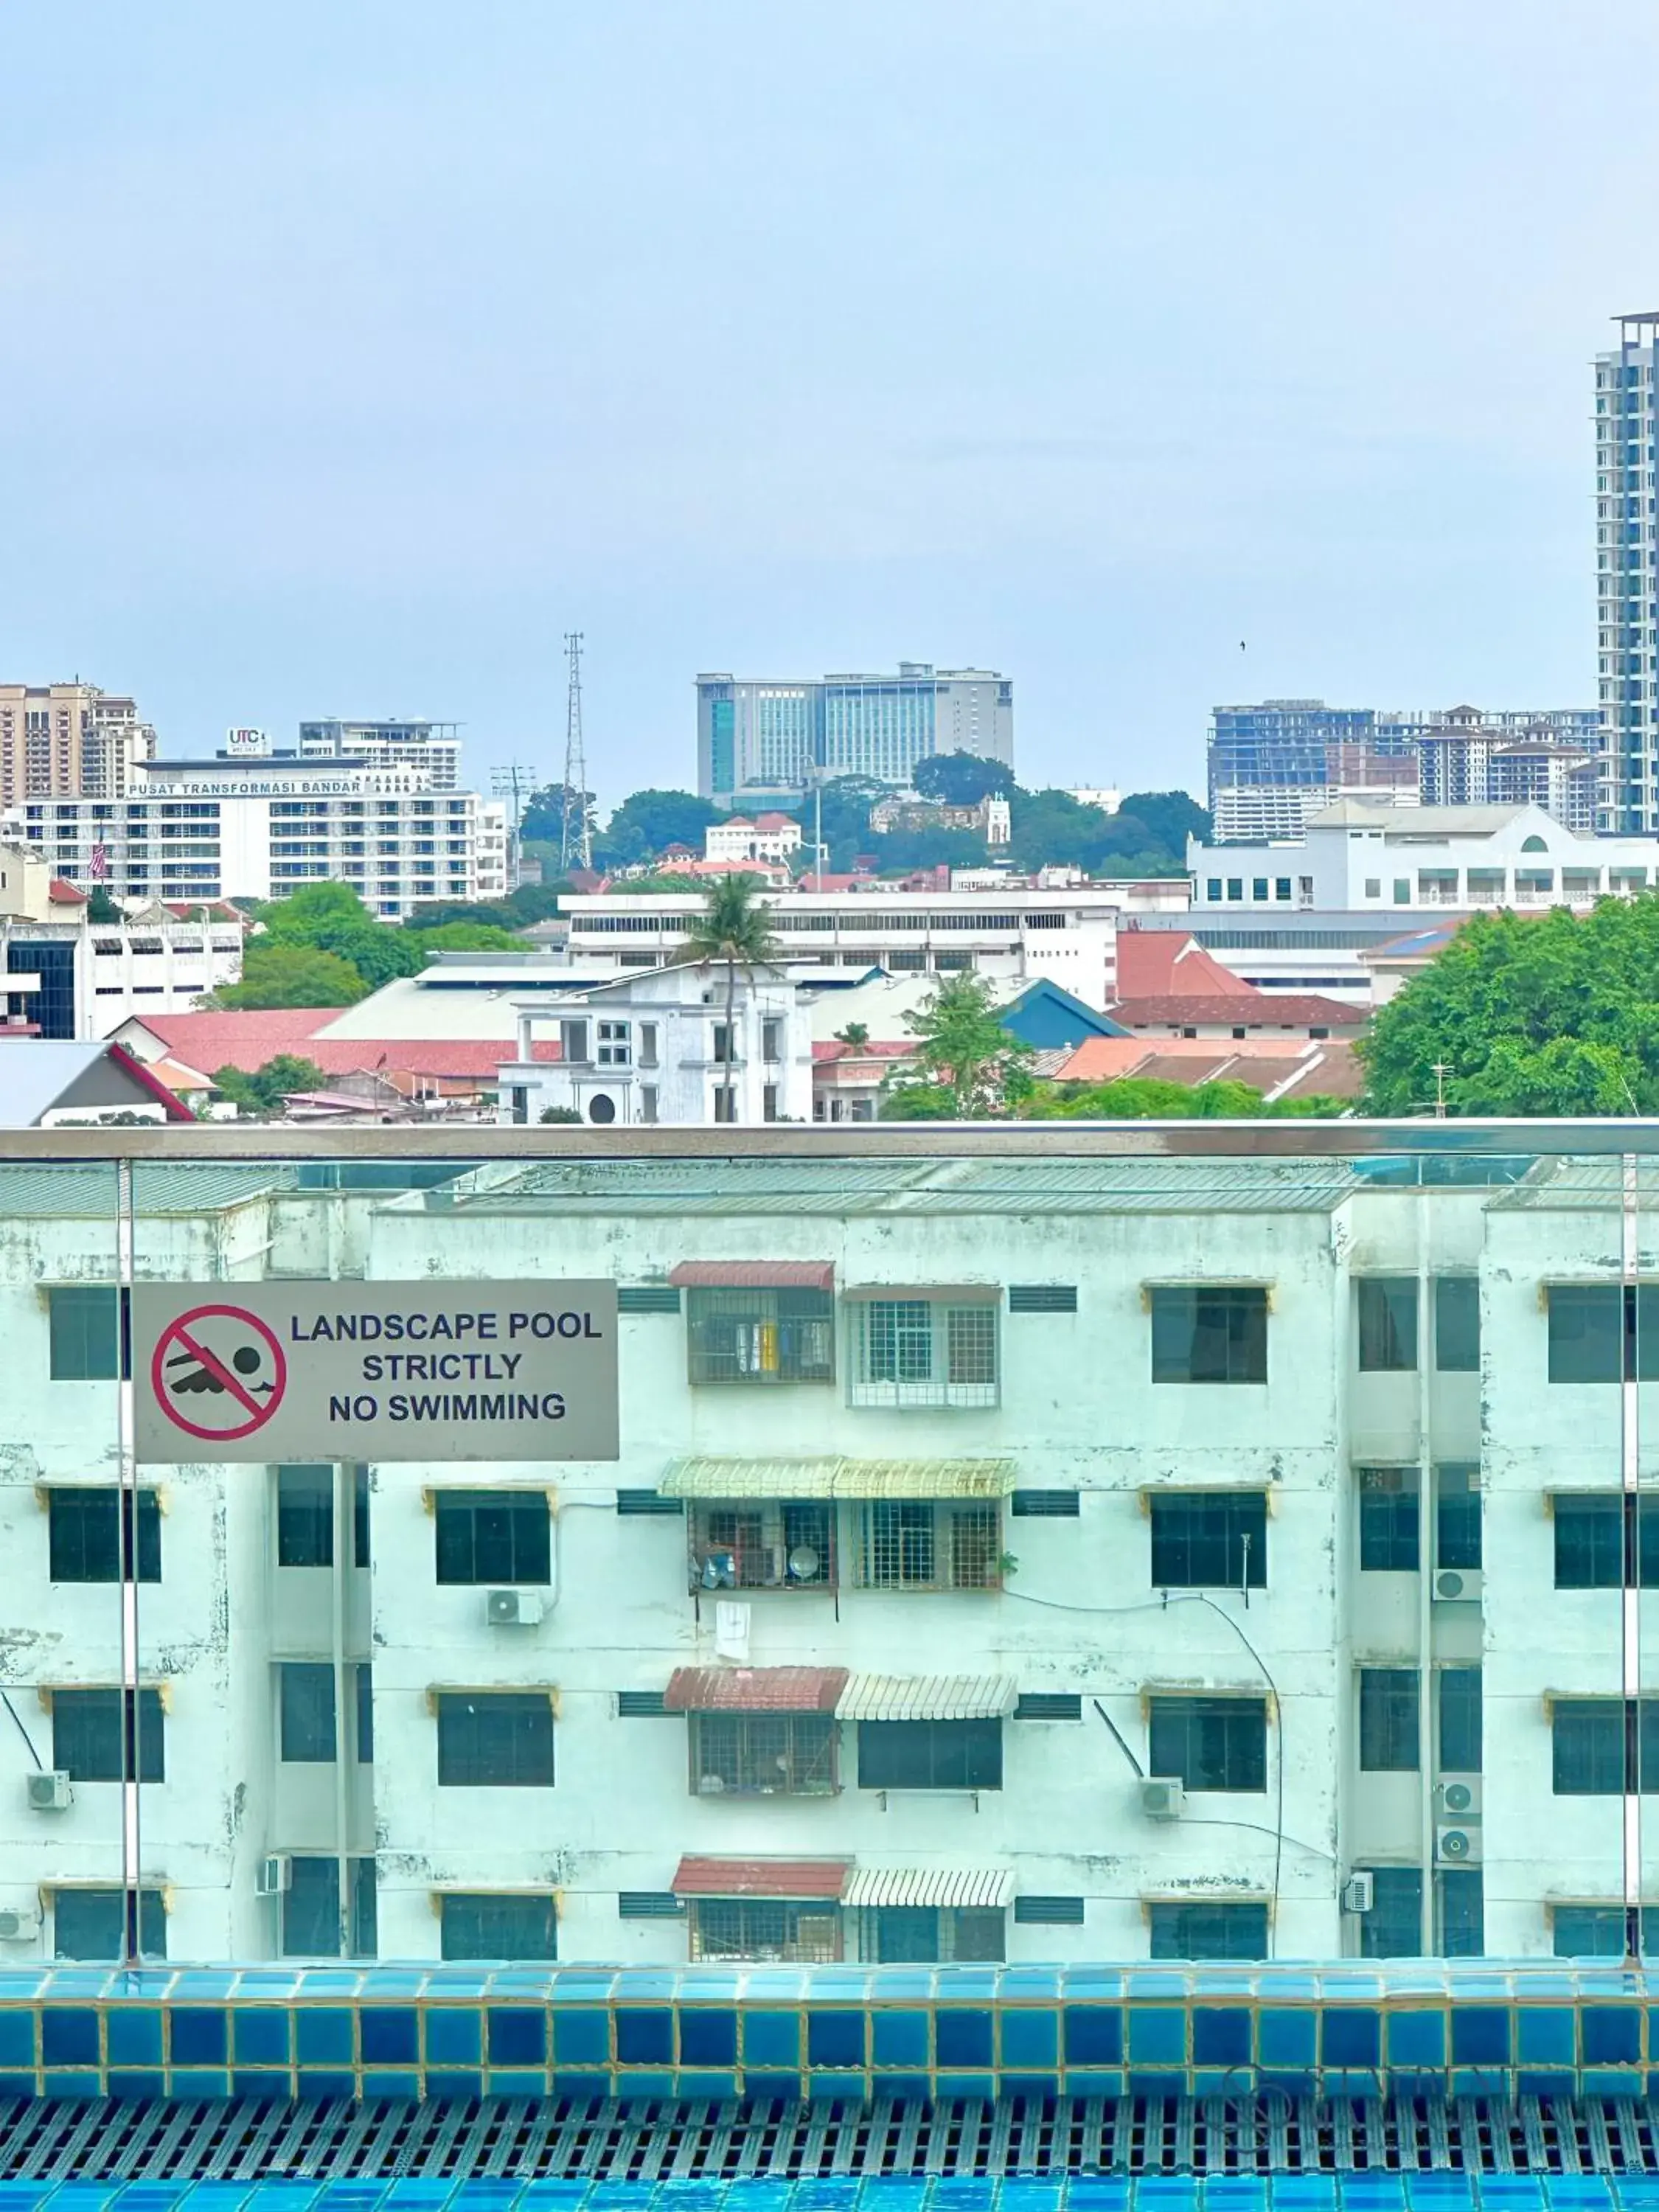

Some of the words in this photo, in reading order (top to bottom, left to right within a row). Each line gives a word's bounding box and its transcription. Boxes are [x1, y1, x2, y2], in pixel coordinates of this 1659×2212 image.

[230, 729, 259, 744] UTC
[129, 785, 176, 794] PUSAT
[183, 782, 296, 794] TRANSFORMASI
[302, 782, 361, 793] BANDAR
[291, 1313, 498, 1341] LANDSCAPE
[509, 1312, 602, 1339] POOL
[363, 1353, 522, 1381] STRICTLY
[330, 1394, 378, 1422] NO
[389, 1393, 566, 1421] SWIMMING
